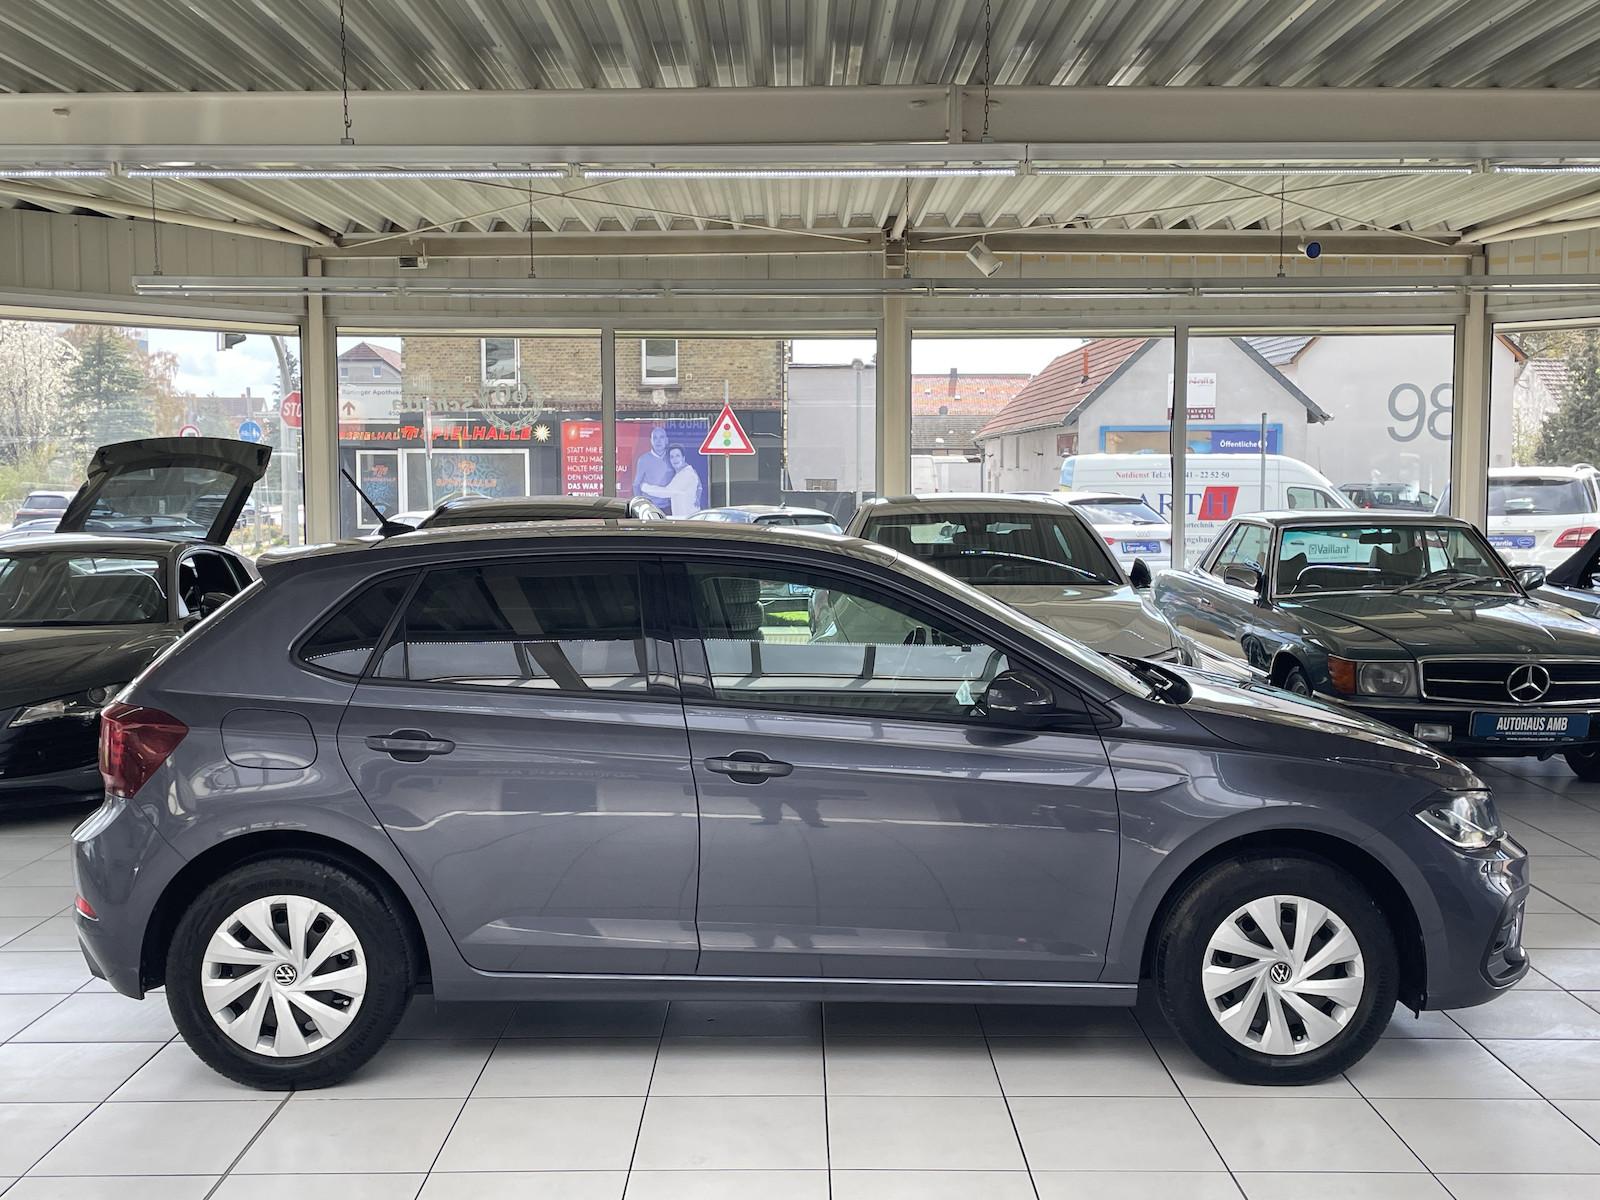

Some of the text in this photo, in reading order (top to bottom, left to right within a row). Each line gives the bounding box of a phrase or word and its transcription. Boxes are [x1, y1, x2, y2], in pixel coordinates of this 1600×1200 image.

[283, 402, 301, 417] STO
[1387, 383, 1453, 442] 98
[1220, 439, 1257, 448] Öffentliche
[1200, 471, 1209, 479] 22
[1211, 471, 1219, 479] 52
[1221, 471, 1230, 479] 50
[1317, 543, 1350, 554] Vaillant
[1496, 716, 1568, 731] AUTOHAUS AMB
